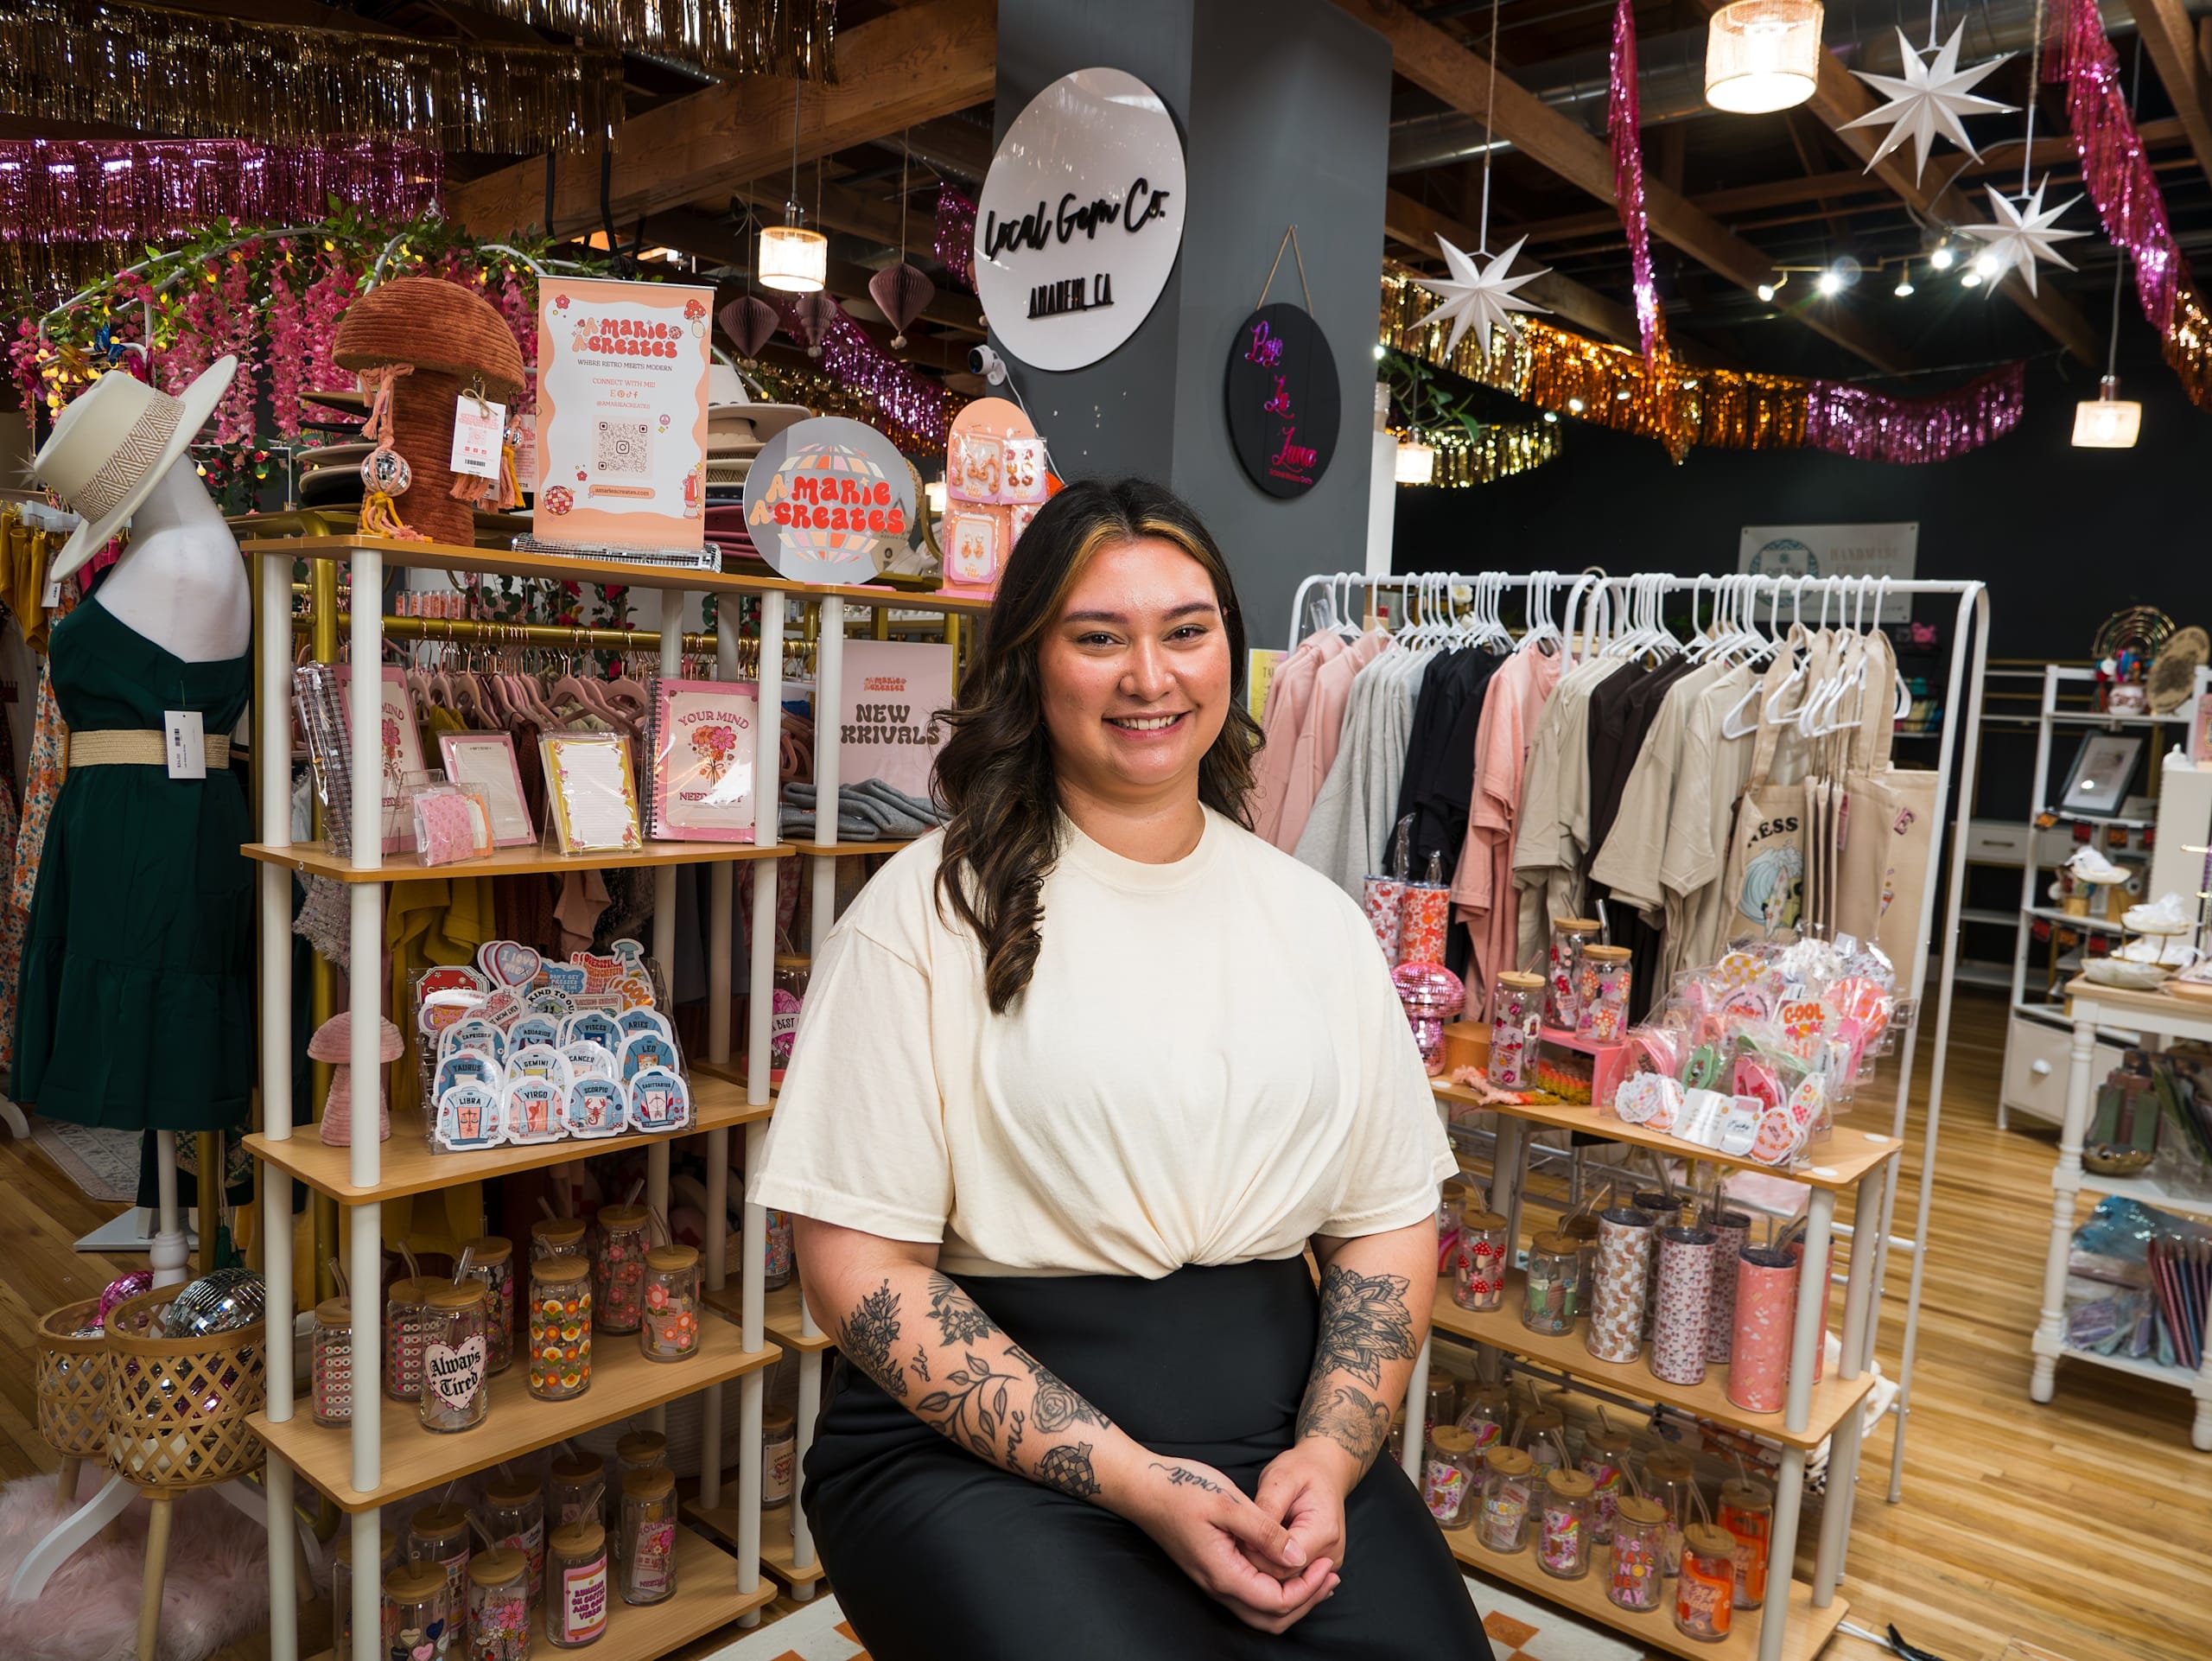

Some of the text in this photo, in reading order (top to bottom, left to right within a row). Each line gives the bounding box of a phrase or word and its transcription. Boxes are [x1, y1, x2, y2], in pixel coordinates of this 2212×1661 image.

[985, 177, 1170, 261] Local Gem Co.
[1095, 273, 1113, 304] CA
[593, 378, 623, 386] CONNECT
[678, 711, 749, 729] YOUR MIND
[855, 704, 910, 723] NEW
[841, 725, 940, 745] RRIVALS
[511, 951, 536, 967] love
[528, 990, 551, 1002] KIND
[554, 990, 566, 999] TO
[496, 1010, 508, 1021] MOM
[508, 1005, 519, 1015] EVER
[1783, 1002, 1825, 1024] COOL
[777, 1017, 795, 1030] BEST
[524, 1091, 548, 1099] VIRGO
[429, 1352, 481, 1377] Always
[440, 1367, 478, 1397] Tired
[572, 1604, 589, 1613] AND
